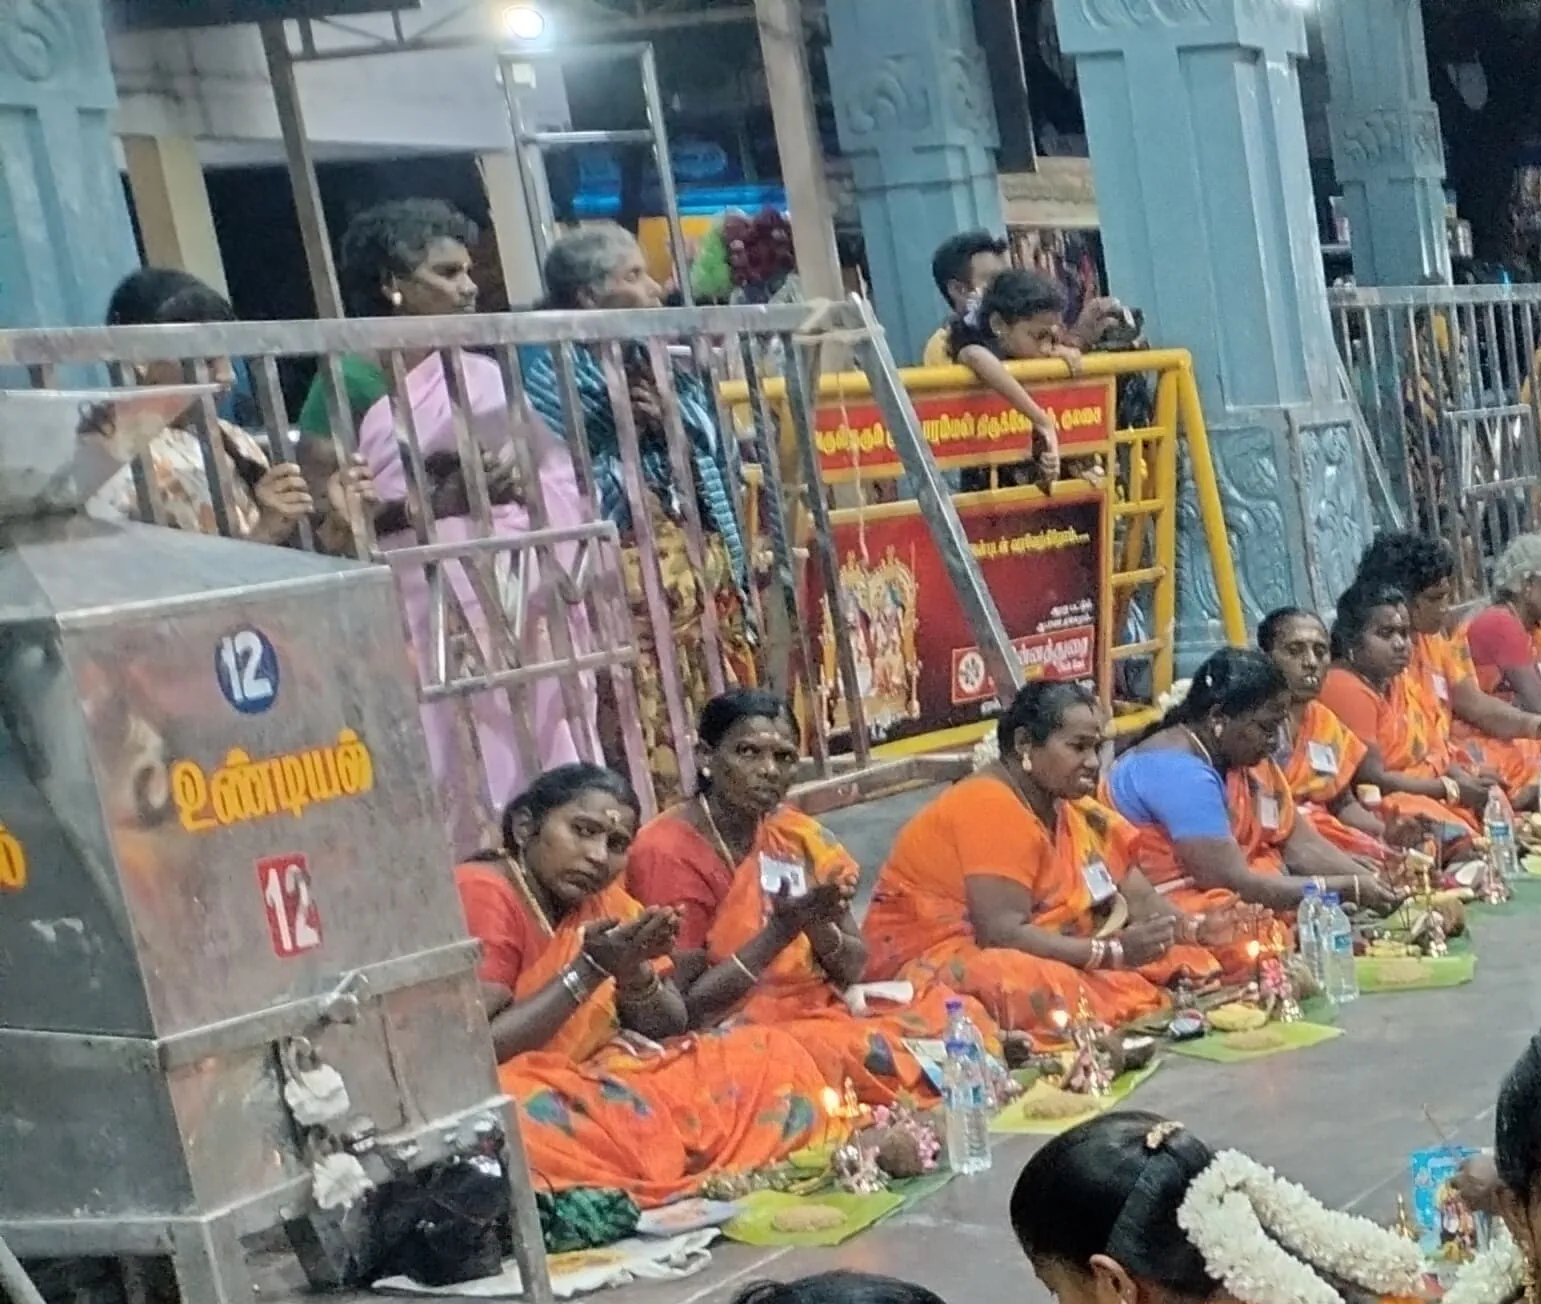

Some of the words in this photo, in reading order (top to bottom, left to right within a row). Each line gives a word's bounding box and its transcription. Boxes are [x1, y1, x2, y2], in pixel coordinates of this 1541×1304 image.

[219, 629, 273, 702] 12
[171, 728, 375, 833] உண்டியல்
[263, 865, 318, 953] 12
